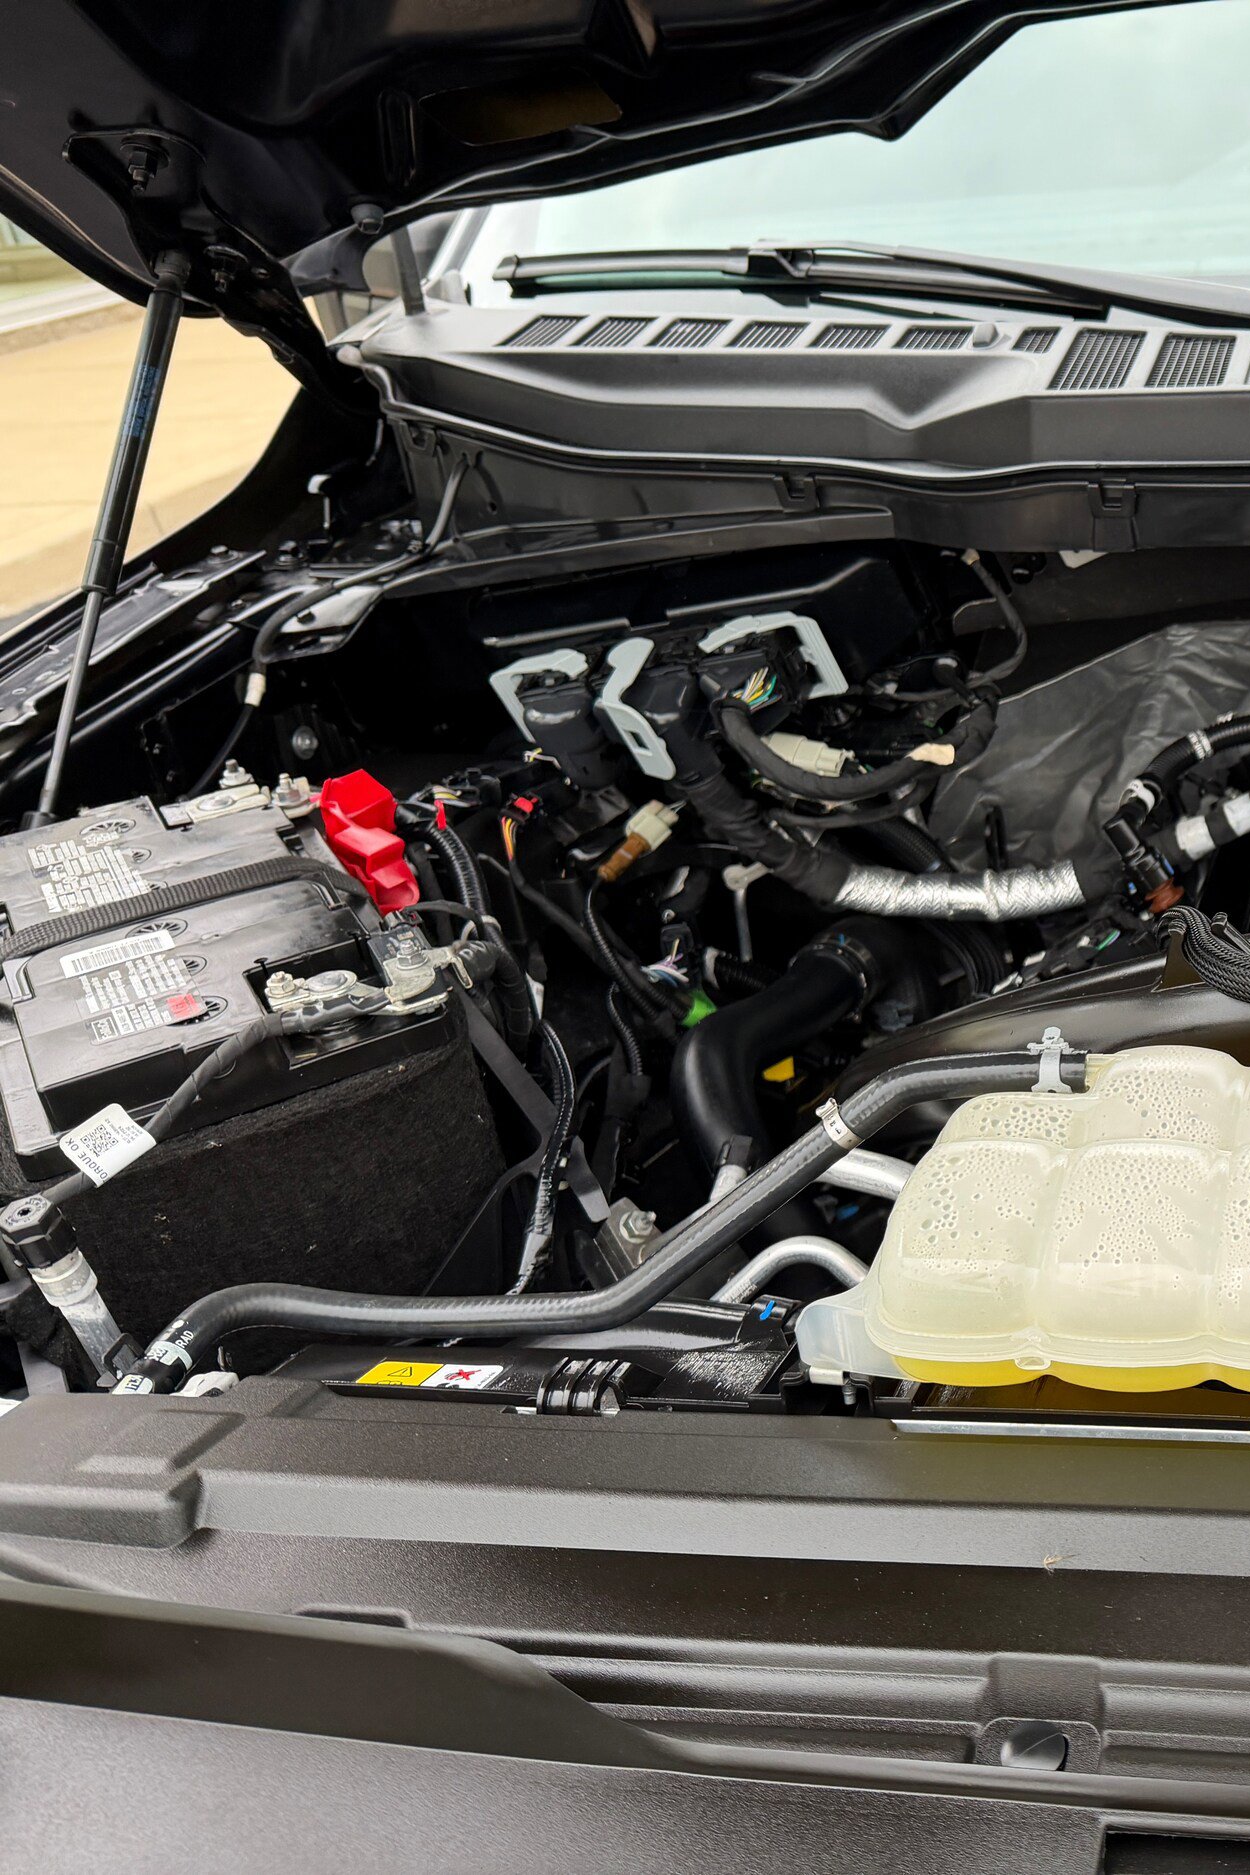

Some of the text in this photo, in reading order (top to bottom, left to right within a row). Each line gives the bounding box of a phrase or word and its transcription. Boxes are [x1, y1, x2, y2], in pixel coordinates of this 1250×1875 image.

[65, 1138, 108, 1182] ORQUE OK
[175, 1330, 194, 1349] RAD
